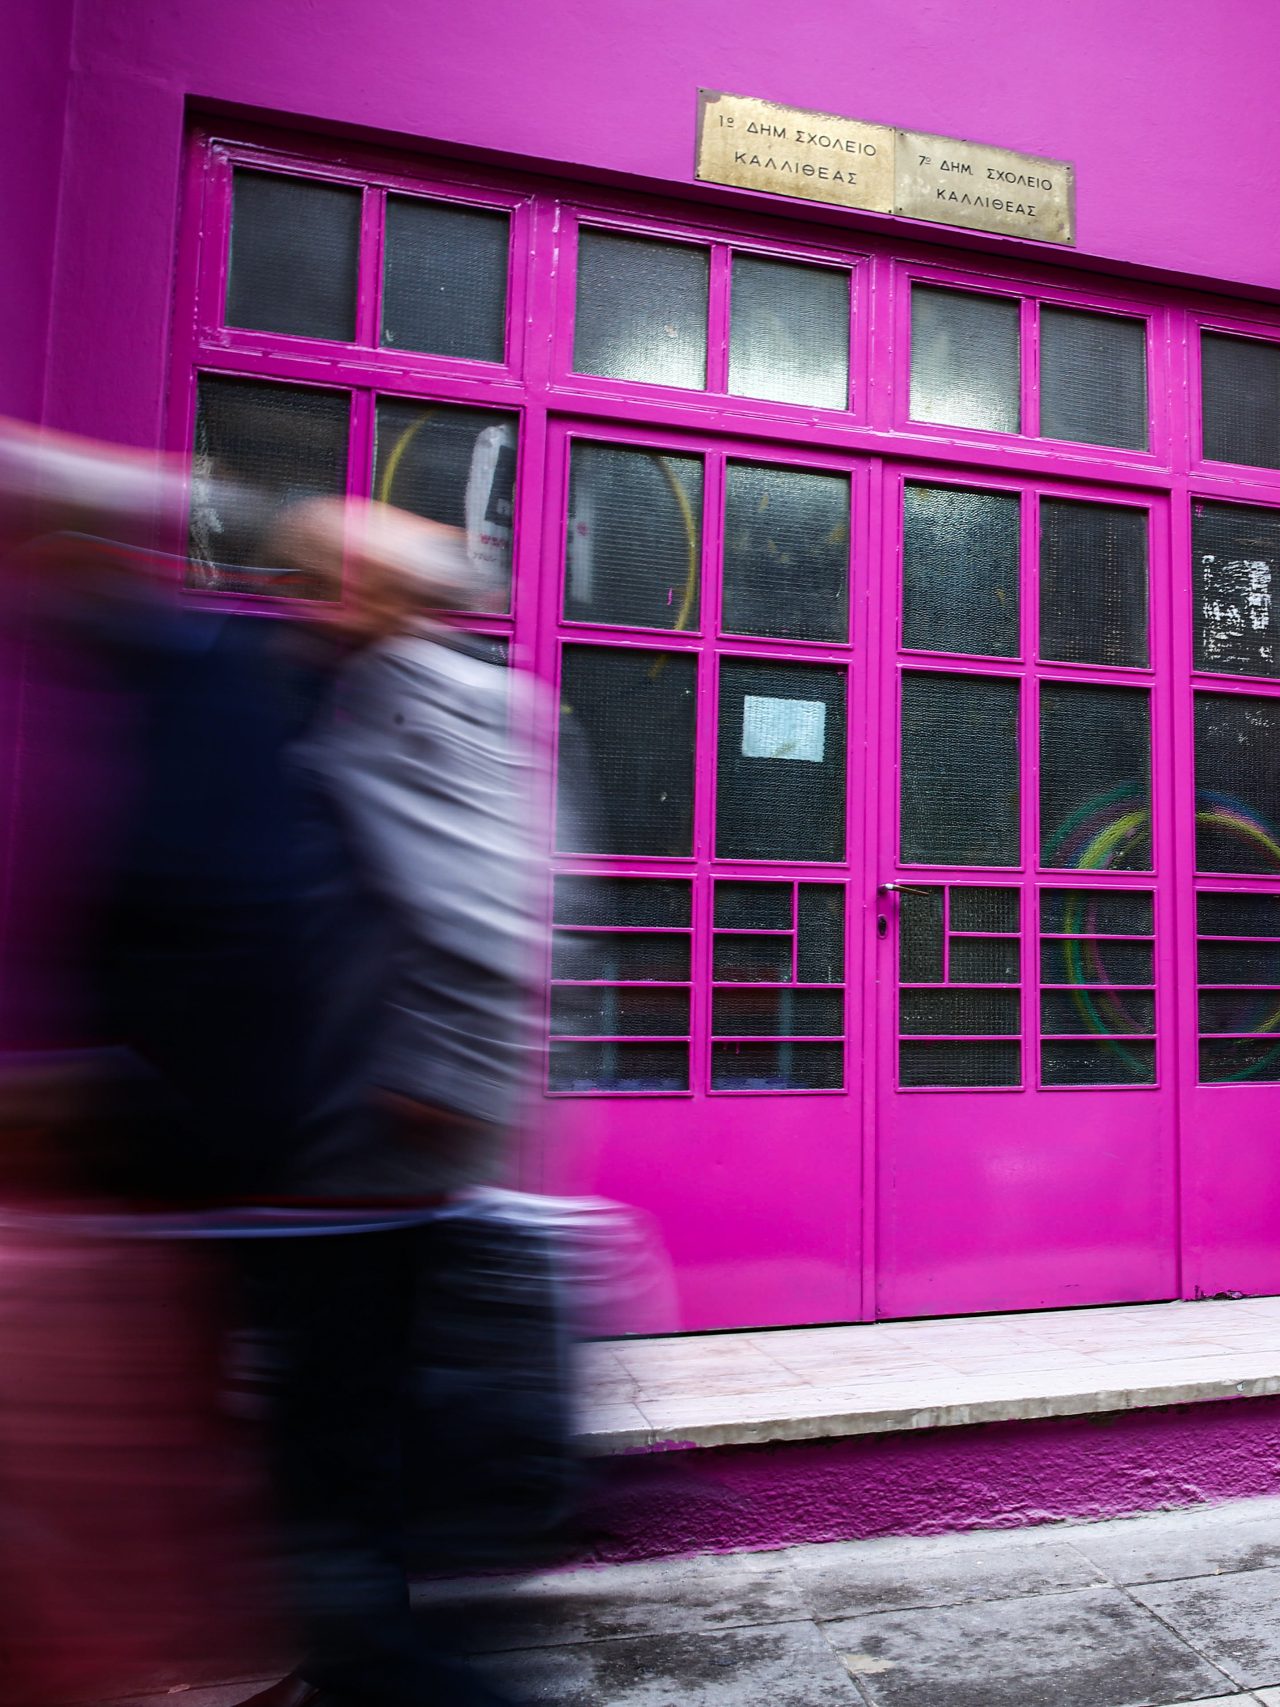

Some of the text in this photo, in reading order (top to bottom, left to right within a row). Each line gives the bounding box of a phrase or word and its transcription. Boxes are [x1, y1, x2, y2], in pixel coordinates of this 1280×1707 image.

[795, 130, 877, 157] ΣΧΟΛΕΙΟ
[734, 151, 858, 185] ΚΑΛΛΙΘΕΑΣ
[986, 168, 1053, 191] ΣΧΟΛΕΙΟ
[936, 188, 1036, 217] ΚΑΛΛΙΘΕΑΣ
